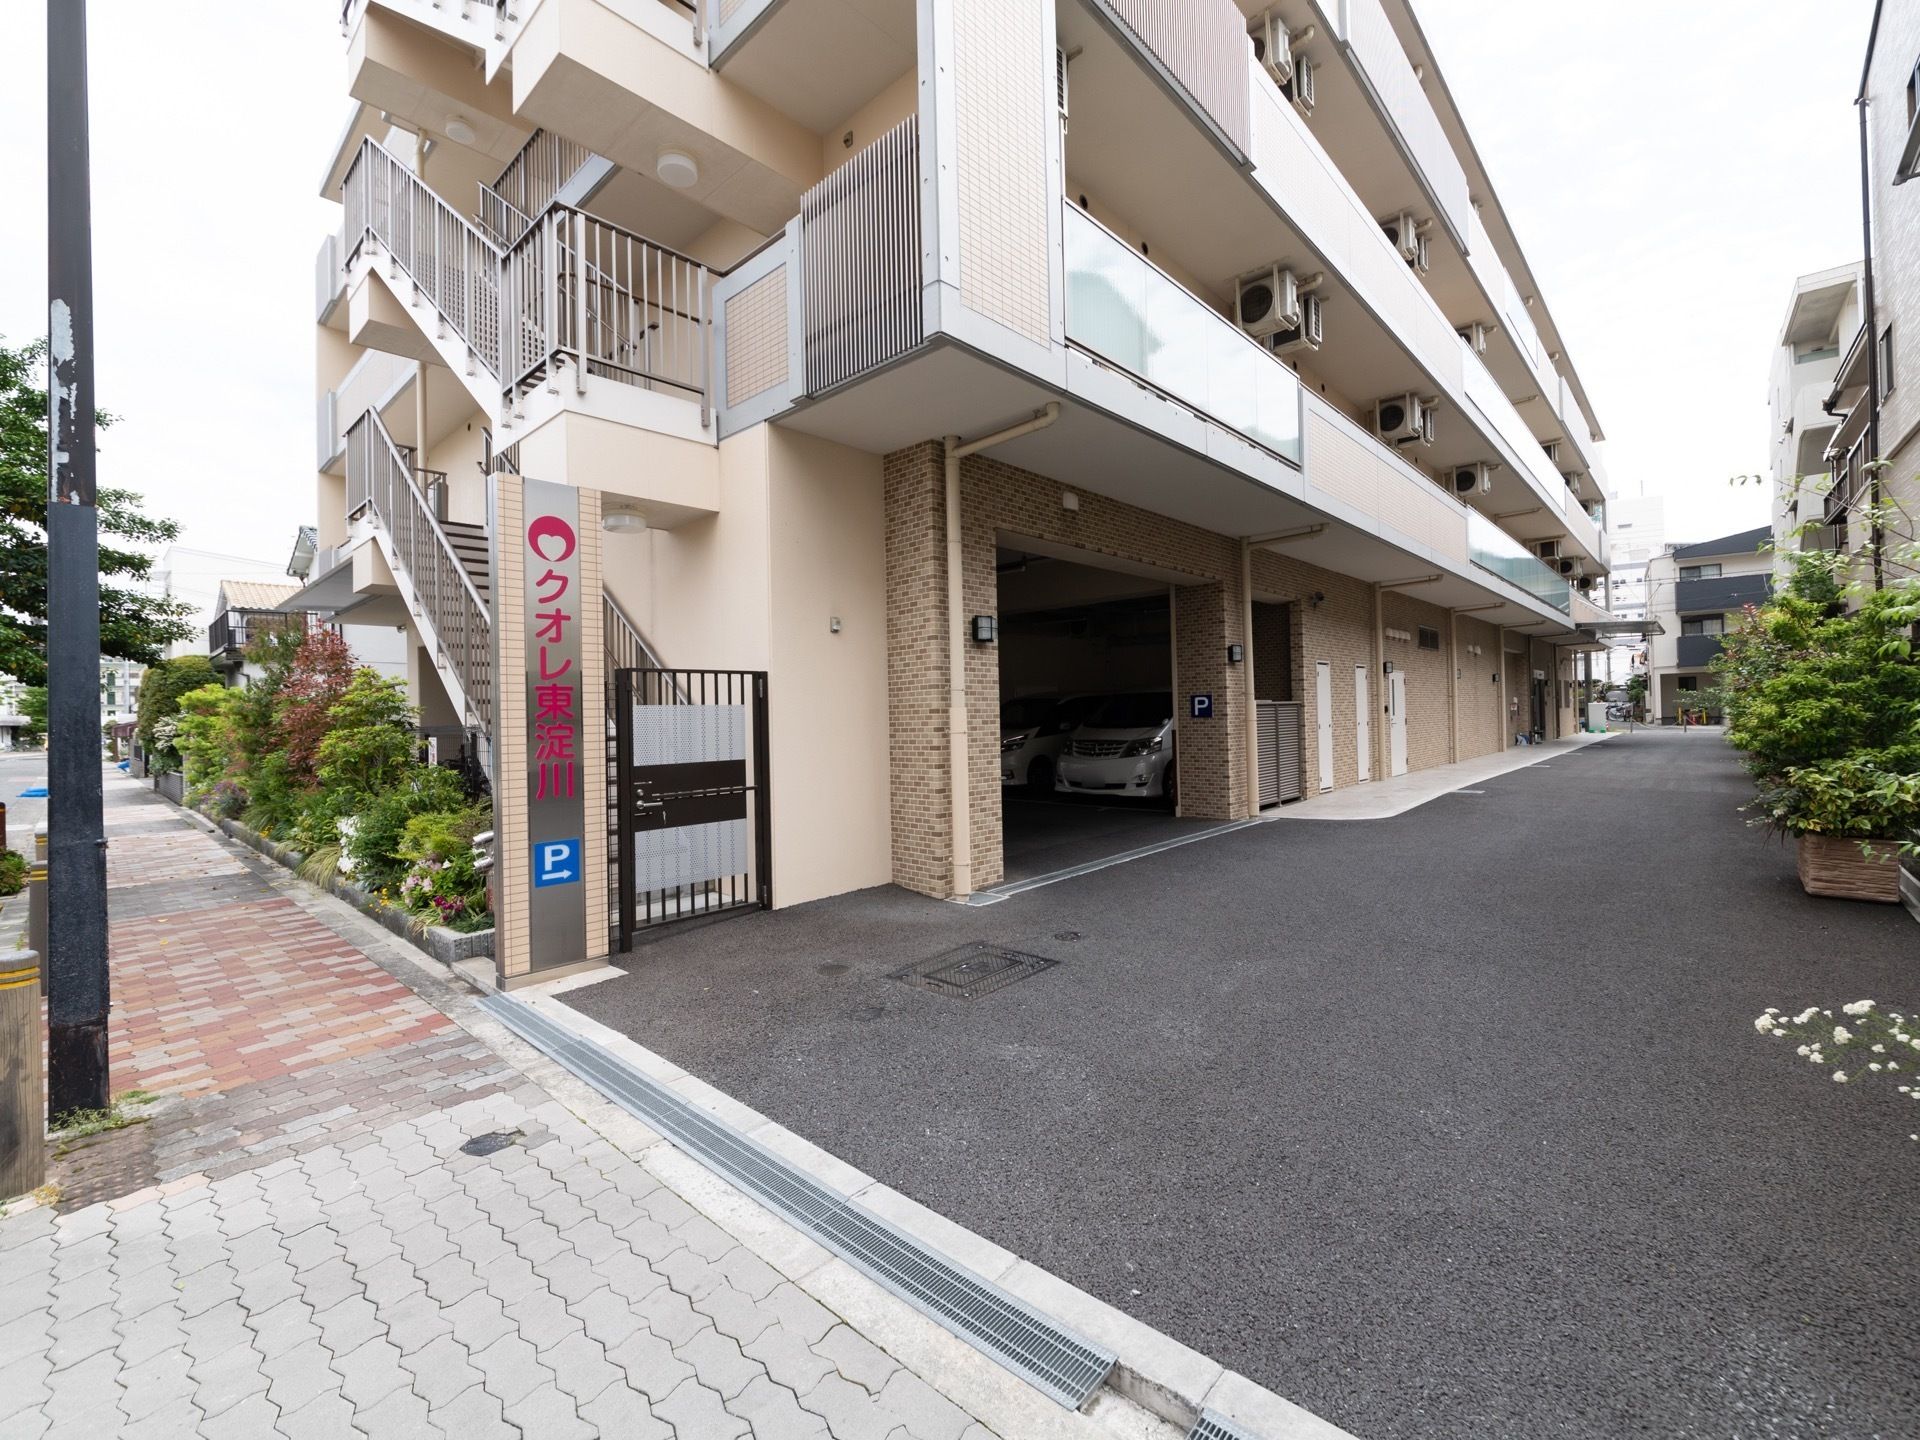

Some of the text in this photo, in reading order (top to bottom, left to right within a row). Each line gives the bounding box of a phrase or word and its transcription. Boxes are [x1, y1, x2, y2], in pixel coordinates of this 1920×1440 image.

[535, 569, 575, 800] クオレ東淀川
[1194, 696, 1209, 716] P
[544, 844, 570, 871] P
